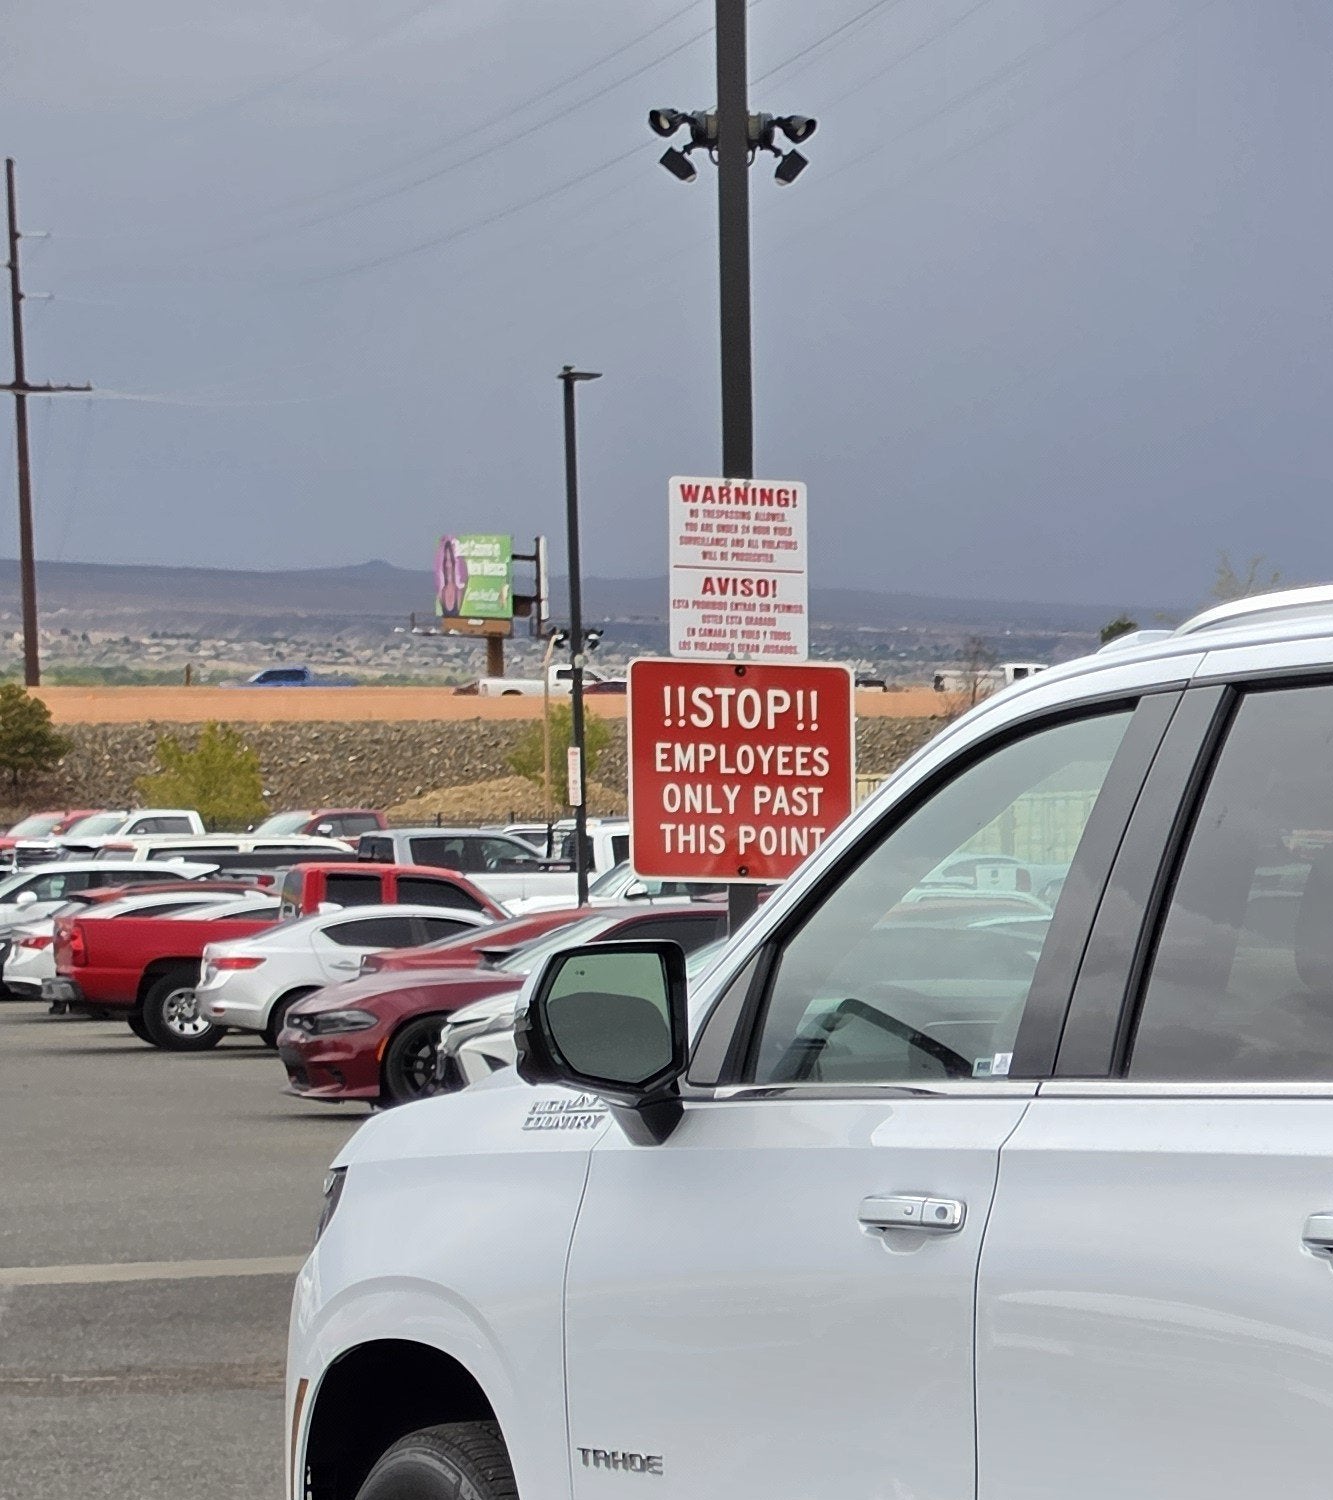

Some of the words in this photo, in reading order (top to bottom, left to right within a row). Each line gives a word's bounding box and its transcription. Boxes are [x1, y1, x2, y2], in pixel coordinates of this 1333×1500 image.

[679, 483, 798, 508] WARNING!
[702, 509, 751, 520] TRESPASSING
[684, 522, 698, 532] YOU
[701, 523, 713, 533] ARE
[716, 523, 739, 534] UNDER
[752, 525, 771, 536] HOUR
[679, 535, 729, 548] SURVEILLANCE
[730, 538, 744, 549] AND
[747, 538, 759, 549] ALL
[761, 540, 798, 551] VIOLATORS
[701, 550, 718, 561] WILL
[701, 576, 778, 599] AVISO!
[730, 601, 757, 613] ENTRAR
[663, 685, 819, 731] !!STOP!!
[655, 742, 830, 777] EMPLOYEES
[662, 783, 741, 815] ONLY
[753, 786, 824, 816] PAST
[659, 823, 726, 855] THIS
[738, 825, 826, 856] POINT
[576, 1447, 664, 1475] TAHOE
